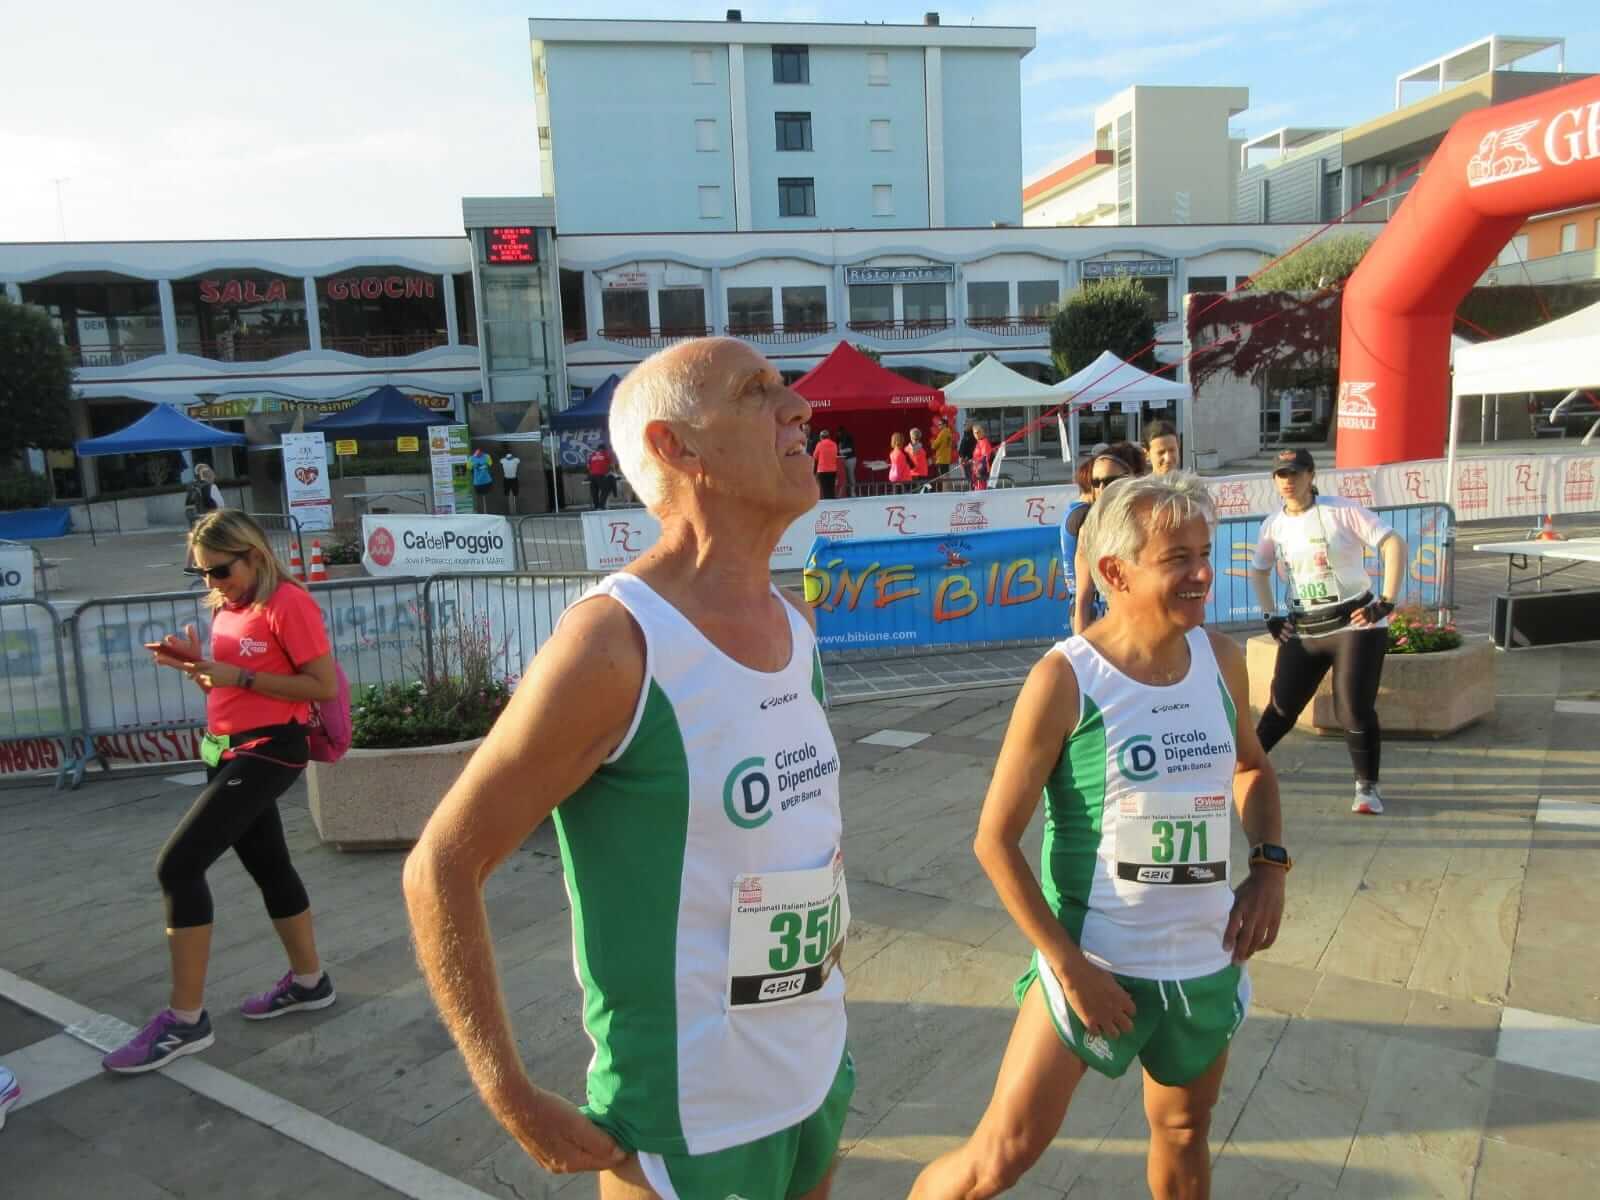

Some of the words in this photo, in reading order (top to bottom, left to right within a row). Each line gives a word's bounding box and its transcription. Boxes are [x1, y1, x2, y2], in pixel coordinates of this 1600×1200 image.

[200, 280, 288, 303] SALA
[328, 276, 435, 300] GIOCHI
[935, 557, 1067, 623] BIBI
[1299, 582, 1328, 598] 303
[1162, 730, 1207, 746] Circolo
[775, 742, 817, 770] Circolo
[1165, 741, 1232, 762] Dipendenti
[778, 756, 839, 792] Dipendenti
[1191, 762, 1212, 771] Banca
[802, 788, 822, 802] Banca
[1152, 820, 1208, 863] 371
[1140, 870, 1170, 879] 42K
[737, 902, 780, 914] Campionati
[769, 894, 841, 971] 350
[763, 978, 803, 994] 42K
